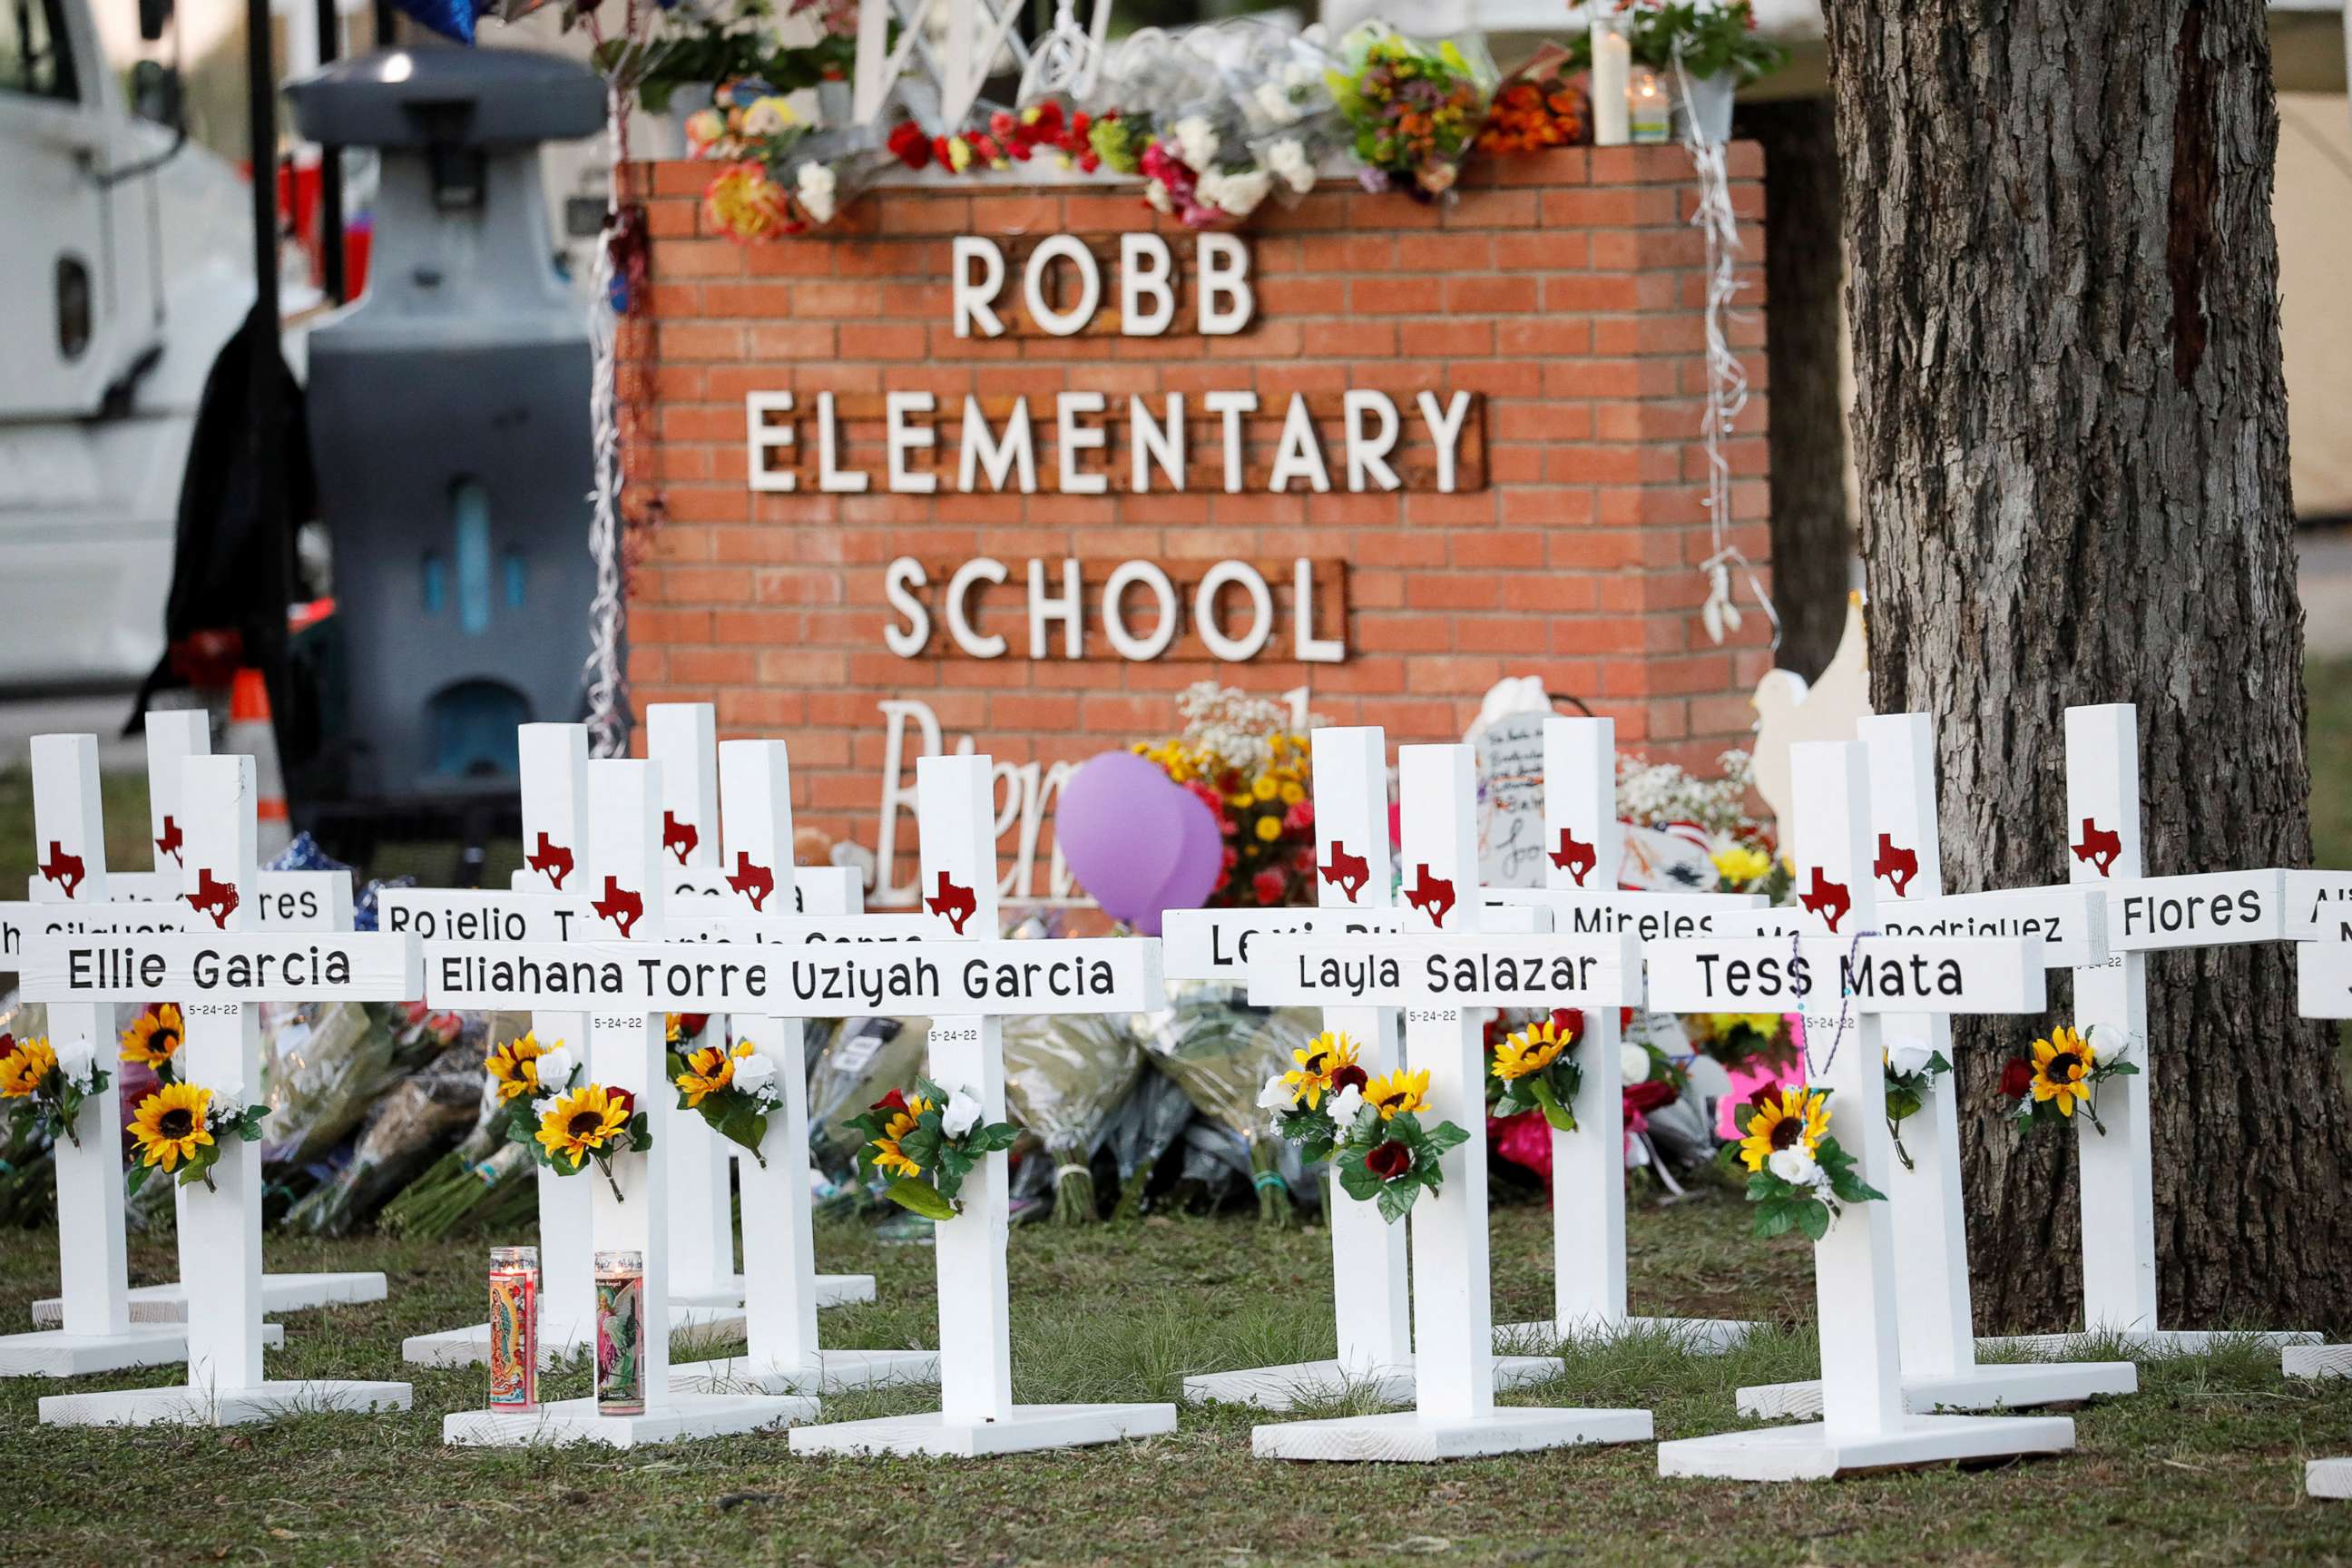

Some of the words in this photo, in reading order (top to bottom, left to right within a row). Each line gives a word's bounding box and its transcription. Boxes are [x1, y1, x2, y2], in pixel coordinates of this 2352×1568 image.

[953, 232, 1254, 338] ROBB
[746, 388, 1472, 493] ELEMENTARY
[884, 555, 1345, 662] SCHOOL
[1574, 906, 1713, 941] Mireles
[2123, 889, 2261, 936] Flores
[69, 947, 166, 988] Ellie
[193, 946, 350, 988] Garcia
[442, 956, 623, 995] Eliahana
[792, 957, 939, 1007] Uziyah
[963, 957, 1114, 999] Garcia
[1299, 955, 1400, 996] Layla
[1426, 954, 1597, 993] Salazar
[1696, 955, 1812, 997] Tess
[1840, 954, 1963, 998] Mata
[190, 1004, 238, 1015] 5-24-22
[594, 1017, 642, 1028] 5-24-22
[1410, 1010, 1455, 1022] 5-24-22
[1807, 1017, 1855, 1029] 5-24-22
[931, 1030, 976, 1042] 5-24-22
